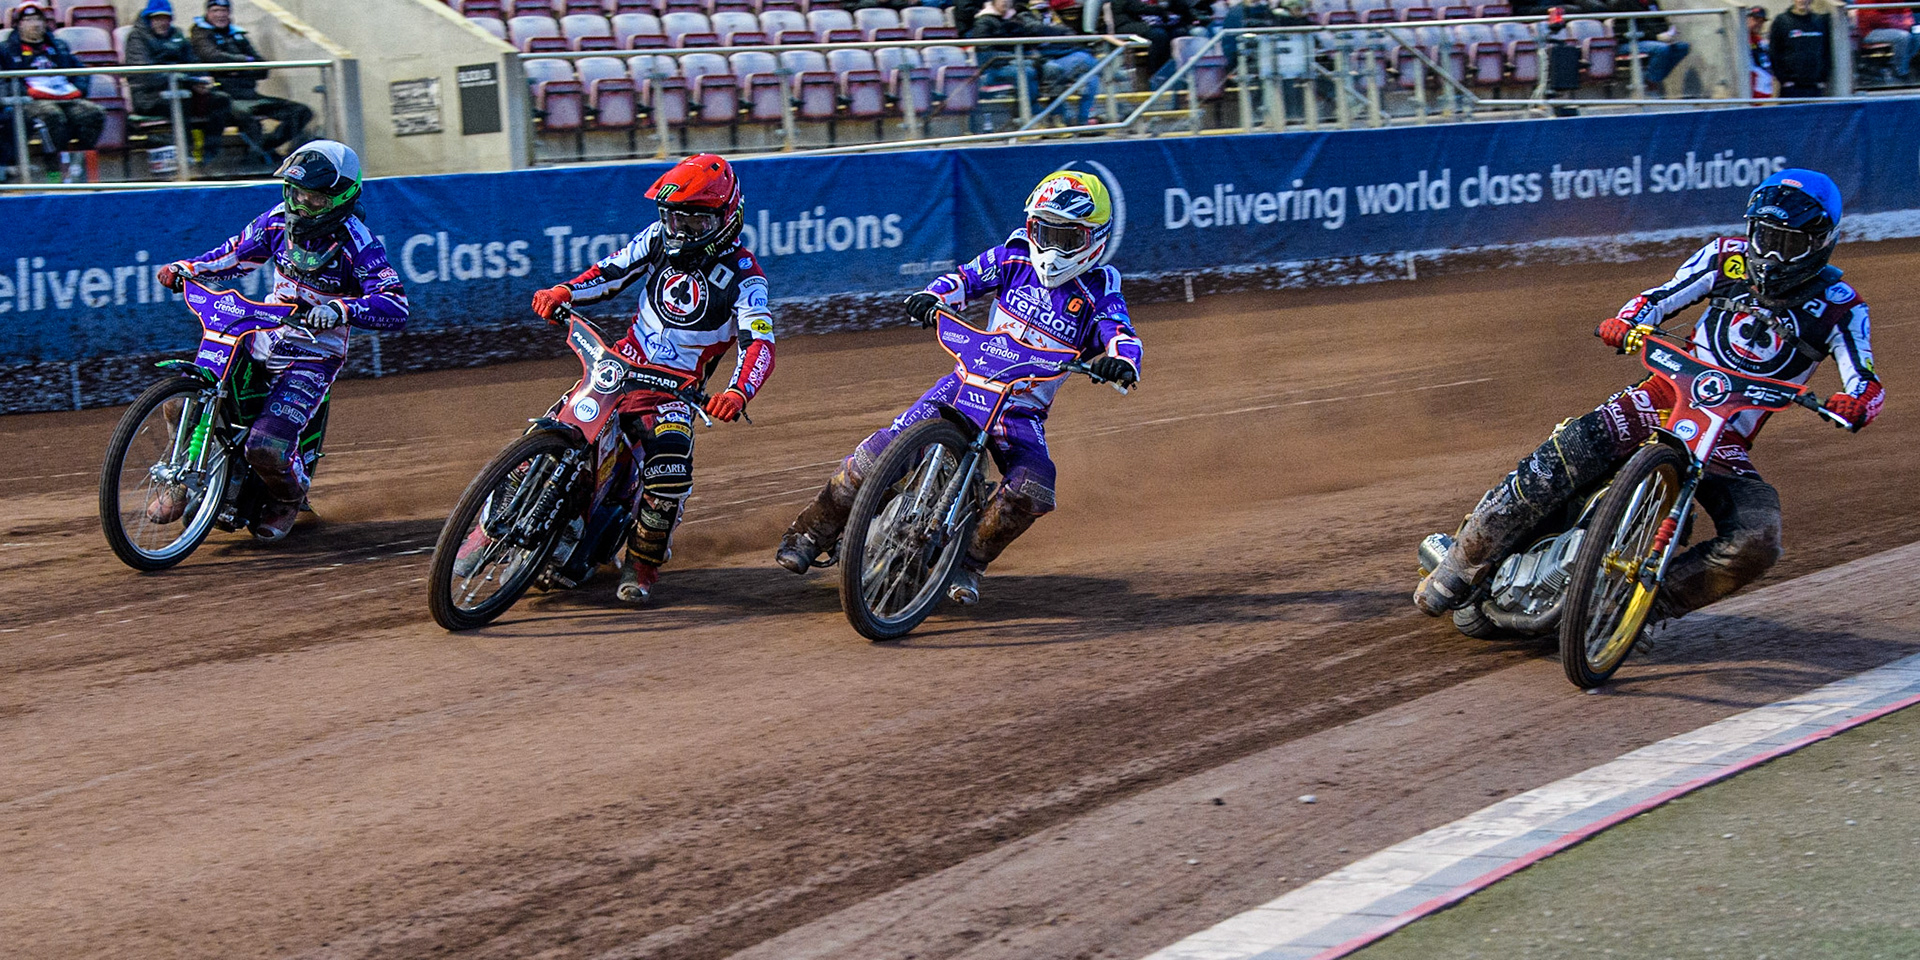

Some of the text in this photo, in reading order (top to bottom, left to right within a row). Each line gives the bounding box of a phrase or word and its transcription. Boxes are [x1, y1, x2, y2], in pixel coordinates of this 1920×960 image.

[1164, 178, 1347, 230] Delivering
[1355, 168, 1451, 216] world
[1459, 165, 1543, 208] class
[1550, 155, 1643, 201] travel
[1649, 149, 1787, 194] solutions
[401, 231, 531, 284] Class
[213, 300, 246, 316] Crendon
[1005, 288, 1078, 339] Crendon
[1067, 297, 1084, 313] 6
[980, 341, 1020, 361] Crendon
[636, 372, 678, 389] BETARD
[579, 403, 594, 416] ATPI
[904, 407, 922, 427] CITY
